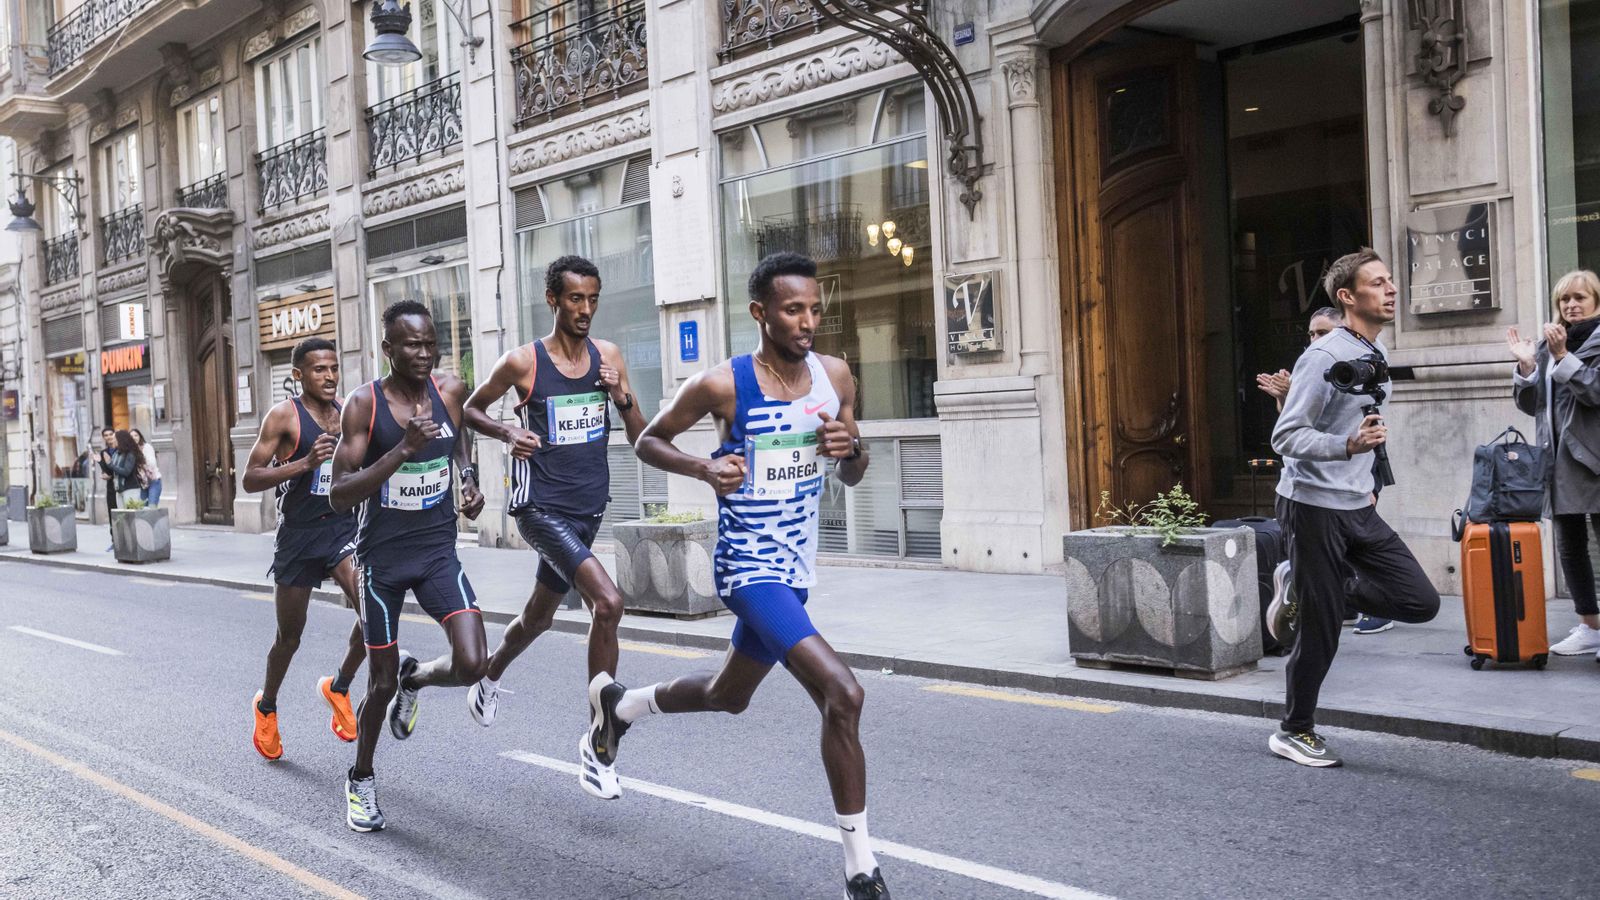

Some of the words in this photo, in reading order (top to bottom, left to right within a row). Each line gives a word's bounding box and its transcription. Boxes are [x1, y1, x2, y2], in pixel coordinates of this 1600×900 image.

[1411, 228, 1486, 246] VINCCI
[1412, 254, 1486, 272] PALACE
[1420, 281, 1480, 297] HOTEL
[271, 303, 322, 338] MUMO
[684, 333, 694, 349] H
[101, 344, 145, 375] DUNKIN'
[582, 406, 589, 416] 2
[558, 415, 603, 431] KEJELCHA
[792, 450, 801, 462] 9
[320, 474, 331, 483] GE
[767, 461, 818, 480] BAREGA
[419, 475, 425, 485] 1
[400, 481, 441, 497] KANDIE
